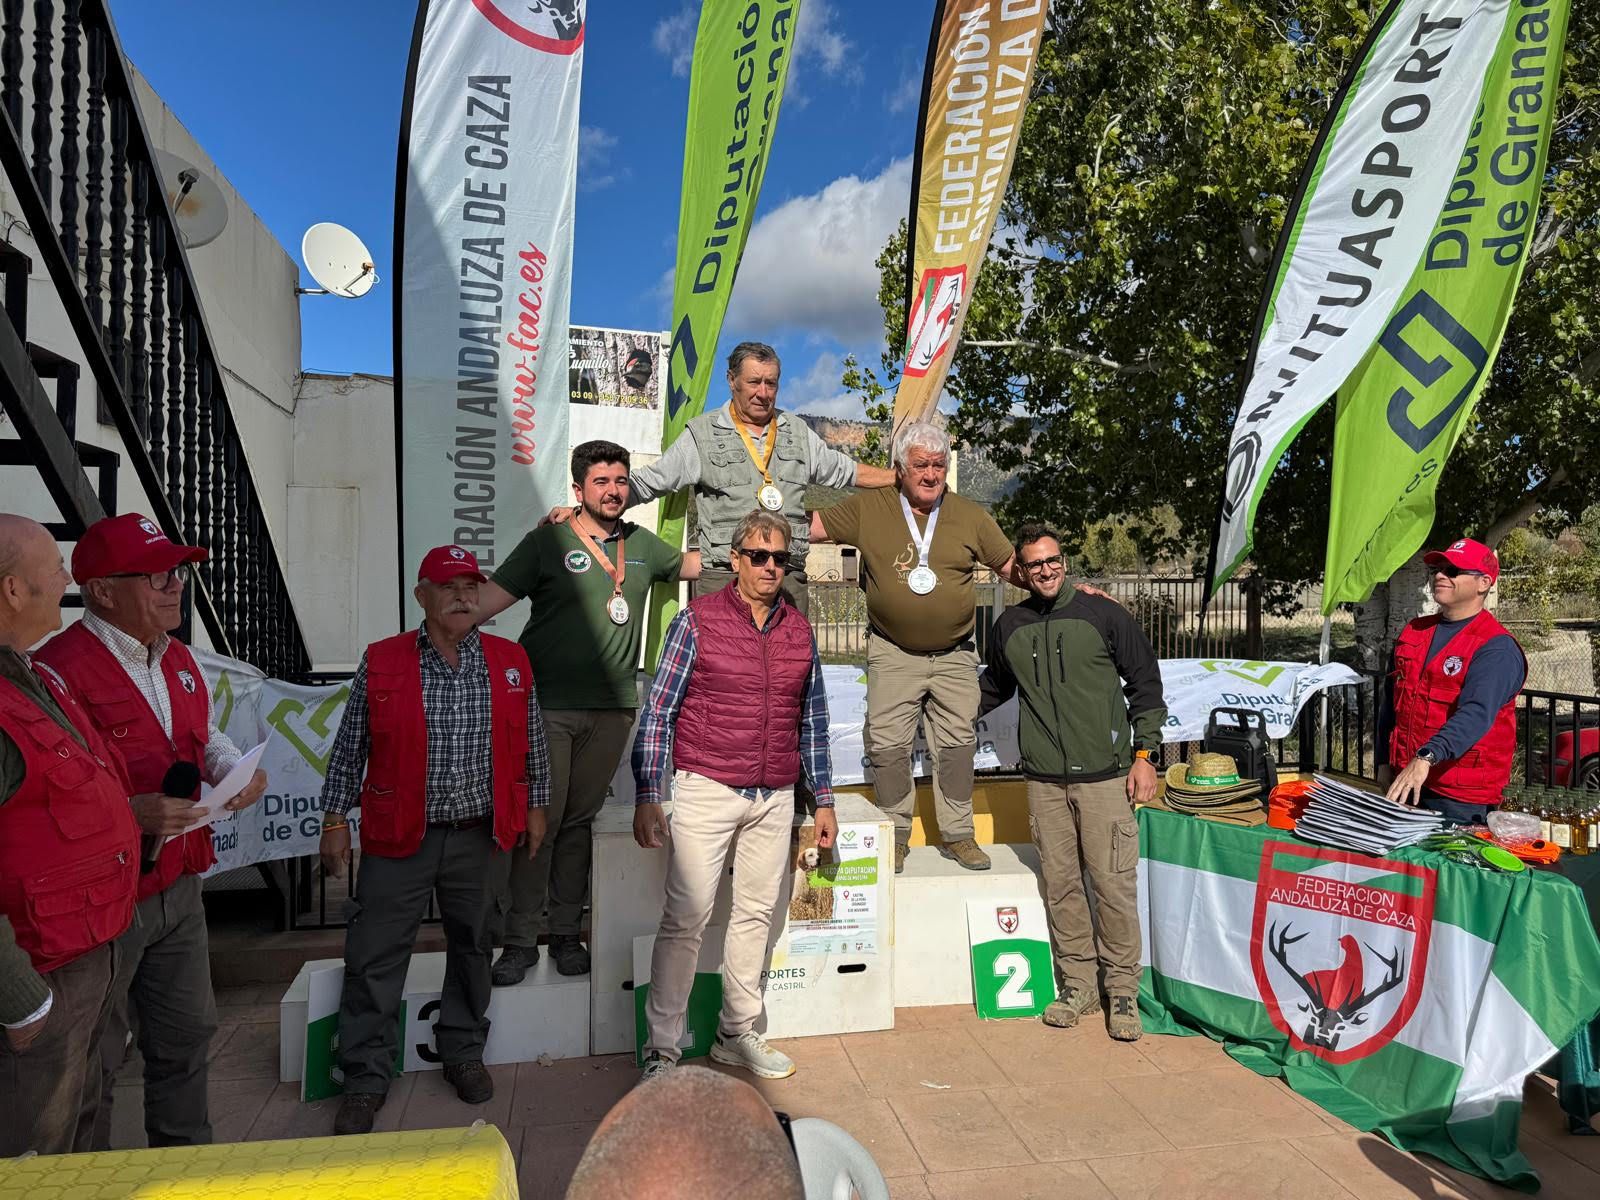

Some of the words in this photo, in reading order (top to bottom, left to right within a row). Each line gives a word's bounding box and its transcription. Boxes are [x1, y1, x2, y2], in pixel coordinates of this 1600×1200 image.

[464, 75, 512, 170] CAZA
[692, 1, 761, 294] Diputació
[932, 2, 991, 253] FEDERACIÓN
[463, 182, 507, 226] DE
[1482, 199, 1529, 267] de
[456, 237, 505, 419] ANDALUZA
[510, 241, 548, 467] www.fac.es
[569, 354, 612, 372] uquillo
[262, 820, 292, 843] de
[1270, 887, 1350, 915] ANDALUZA
[1353, 903, 1374, 920] DE
[1376, 908, 1417, 930] CAZA
[1296, 876, 1395, 908] FEDERACION
[760, 967, 806, 981] PORTES
[772, 982, 807, 991] CASTRIL
[992, 951, 1035, 1010] 2
